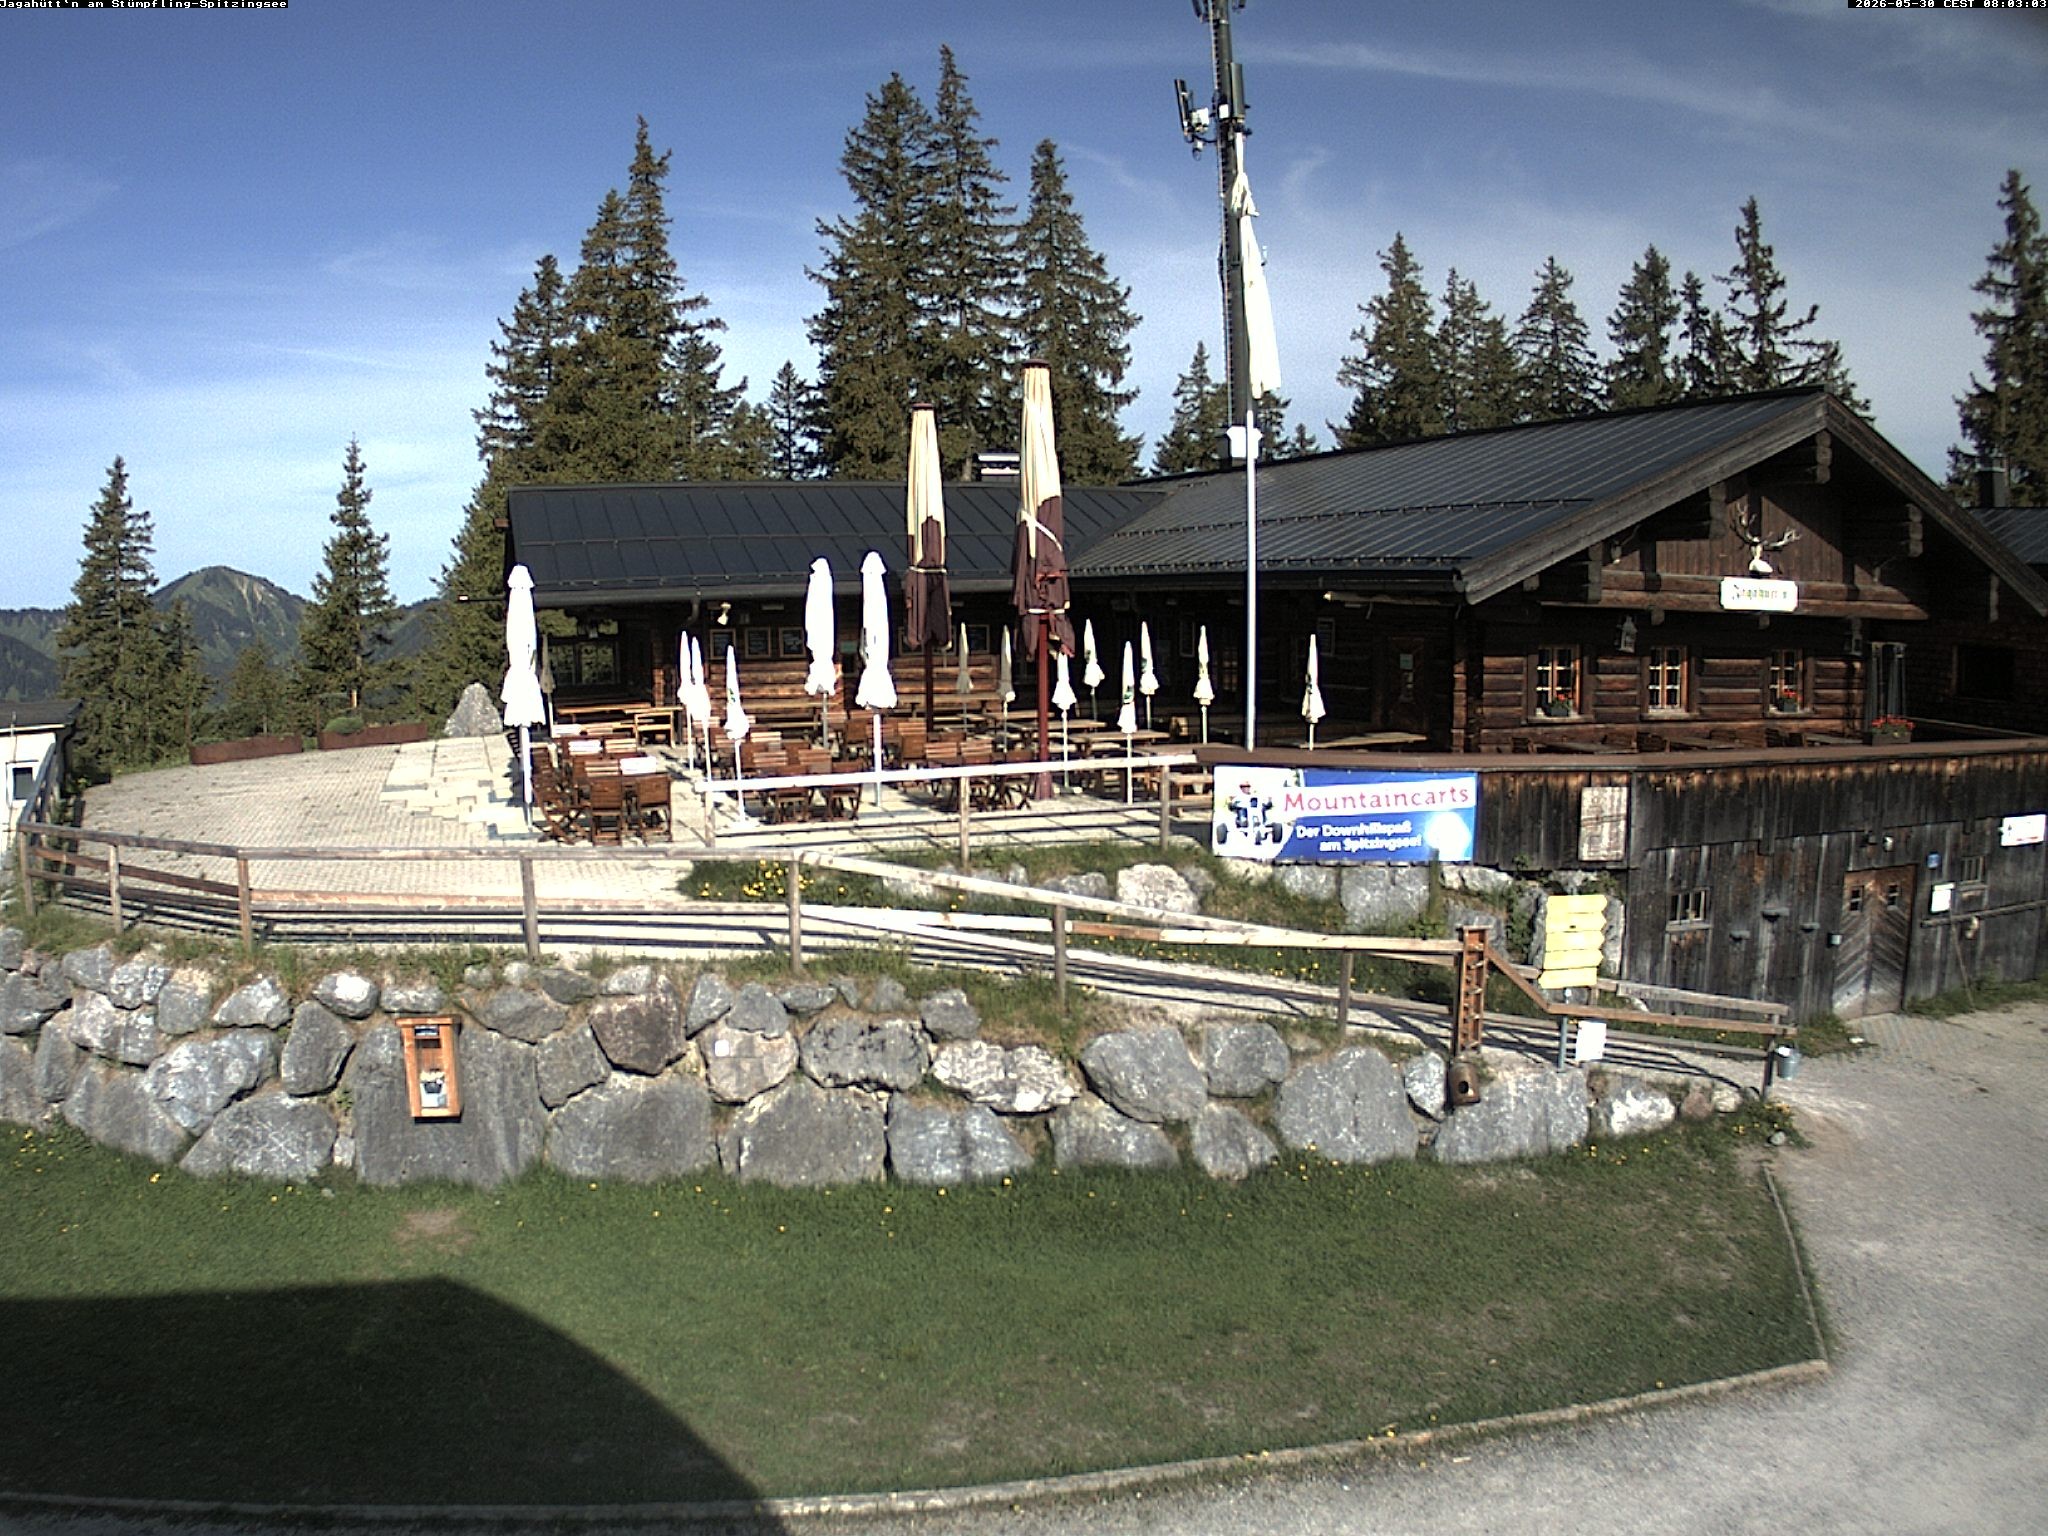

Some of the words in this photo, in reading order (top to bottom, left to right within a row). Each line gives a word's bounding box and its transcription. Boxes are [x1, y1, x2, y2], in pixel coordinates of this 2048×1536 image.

[1283, 786, 1469, 812] Mountaincarts
[1297, 826, 1320, 838] Der
[1320, 841, 1341, 852] am
